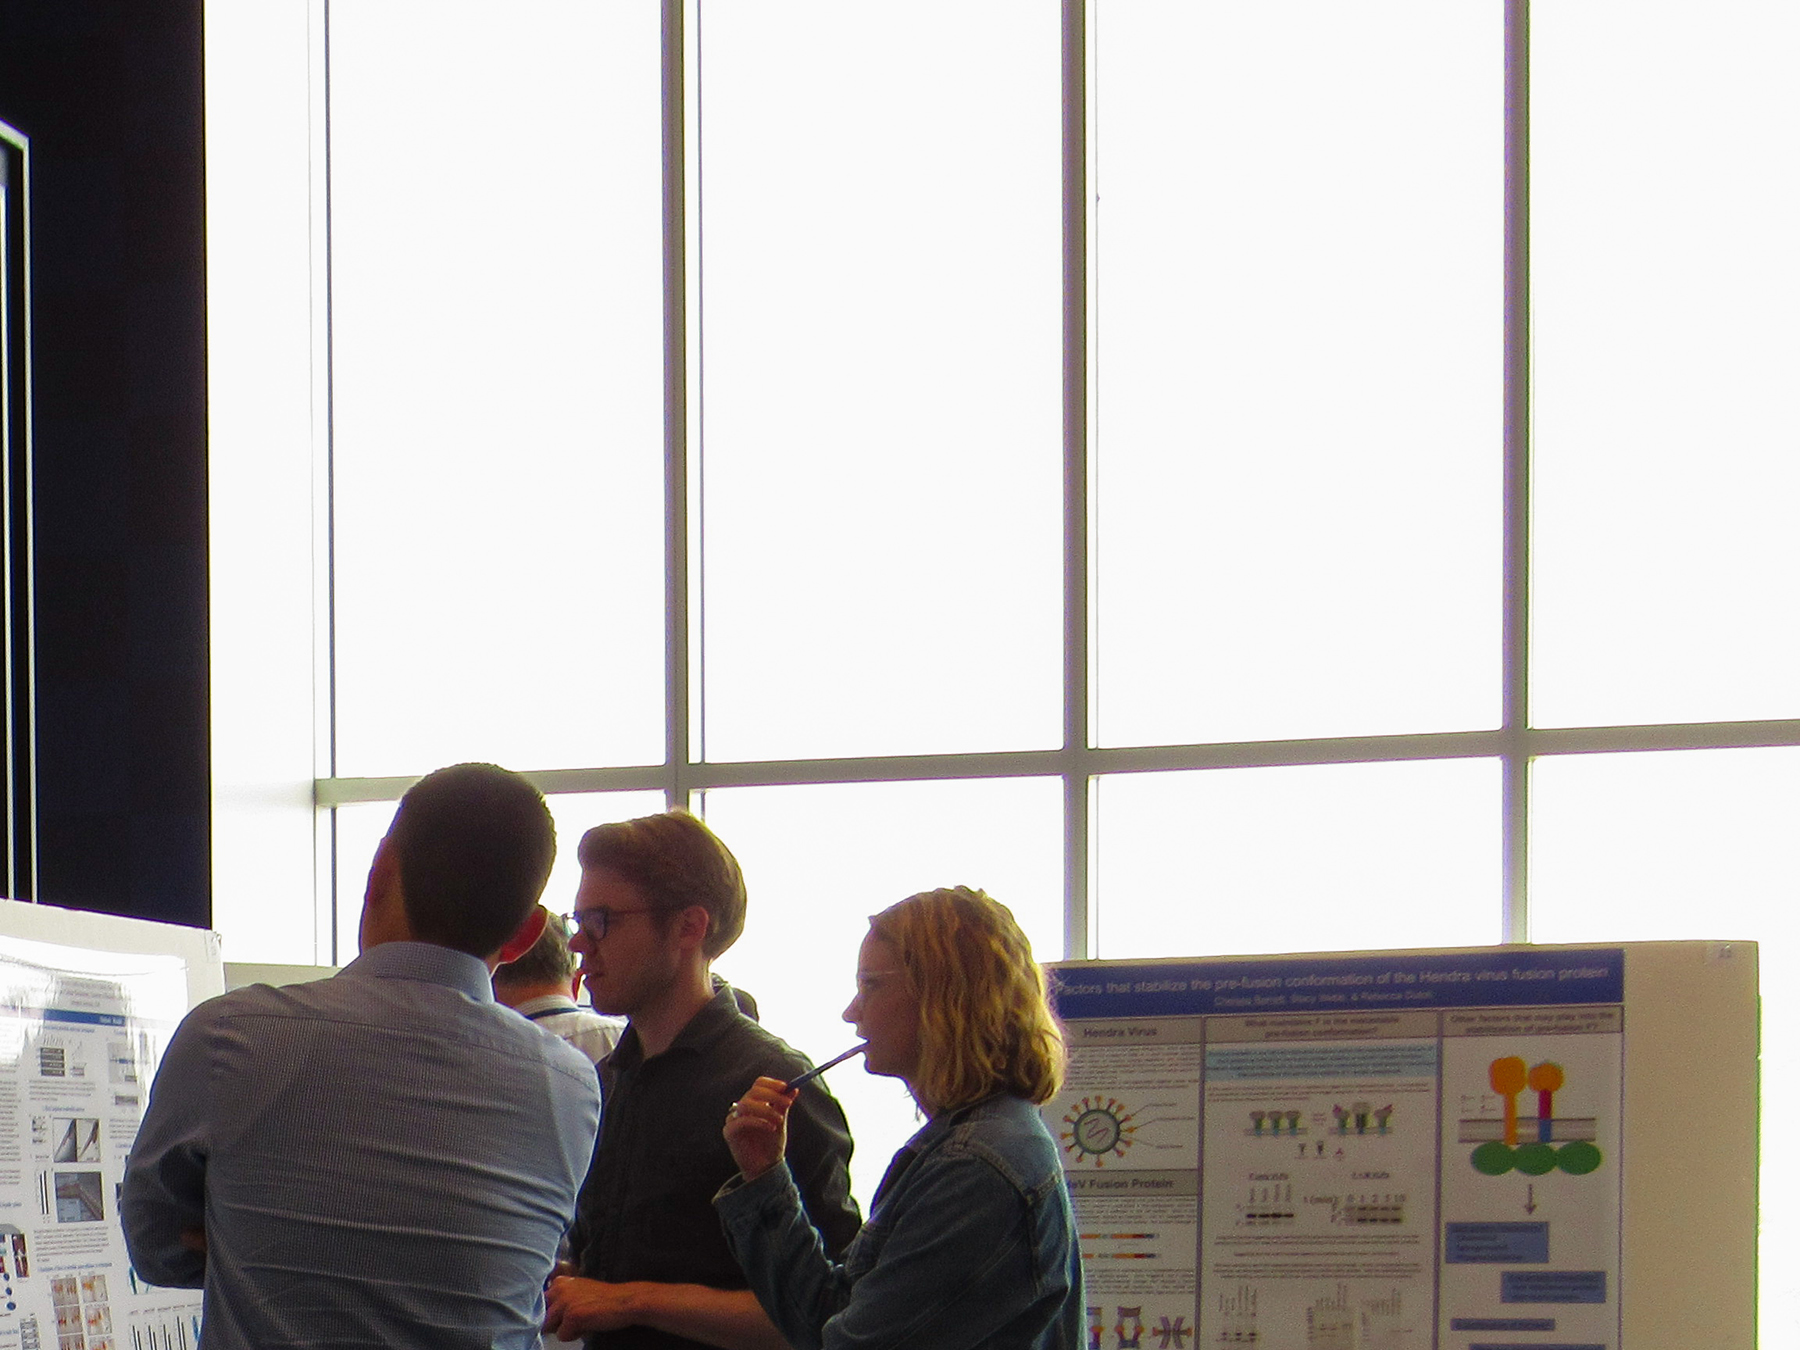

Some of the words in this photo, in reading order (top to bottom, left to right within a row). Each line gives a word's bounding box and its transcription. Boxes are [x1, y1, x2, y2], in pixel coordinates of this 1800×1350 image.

[1106, 982, 1131, 994] that
[1191, 979, 1213, 991] the
[1376, 971, 1392, 985] of
[1393, 971, 1416, 984] the
[1419, 970, 1471, 984] Hendra
[1511, 967, 1555, 980] fusion
[1084, 1027, 1125, 1038] Hendra
[1127, 1026, 1158, 1037] Virus
[1088, 1179, 1128, 1189] Fusion
[1131, 1178, 1174, 1189] Protein
